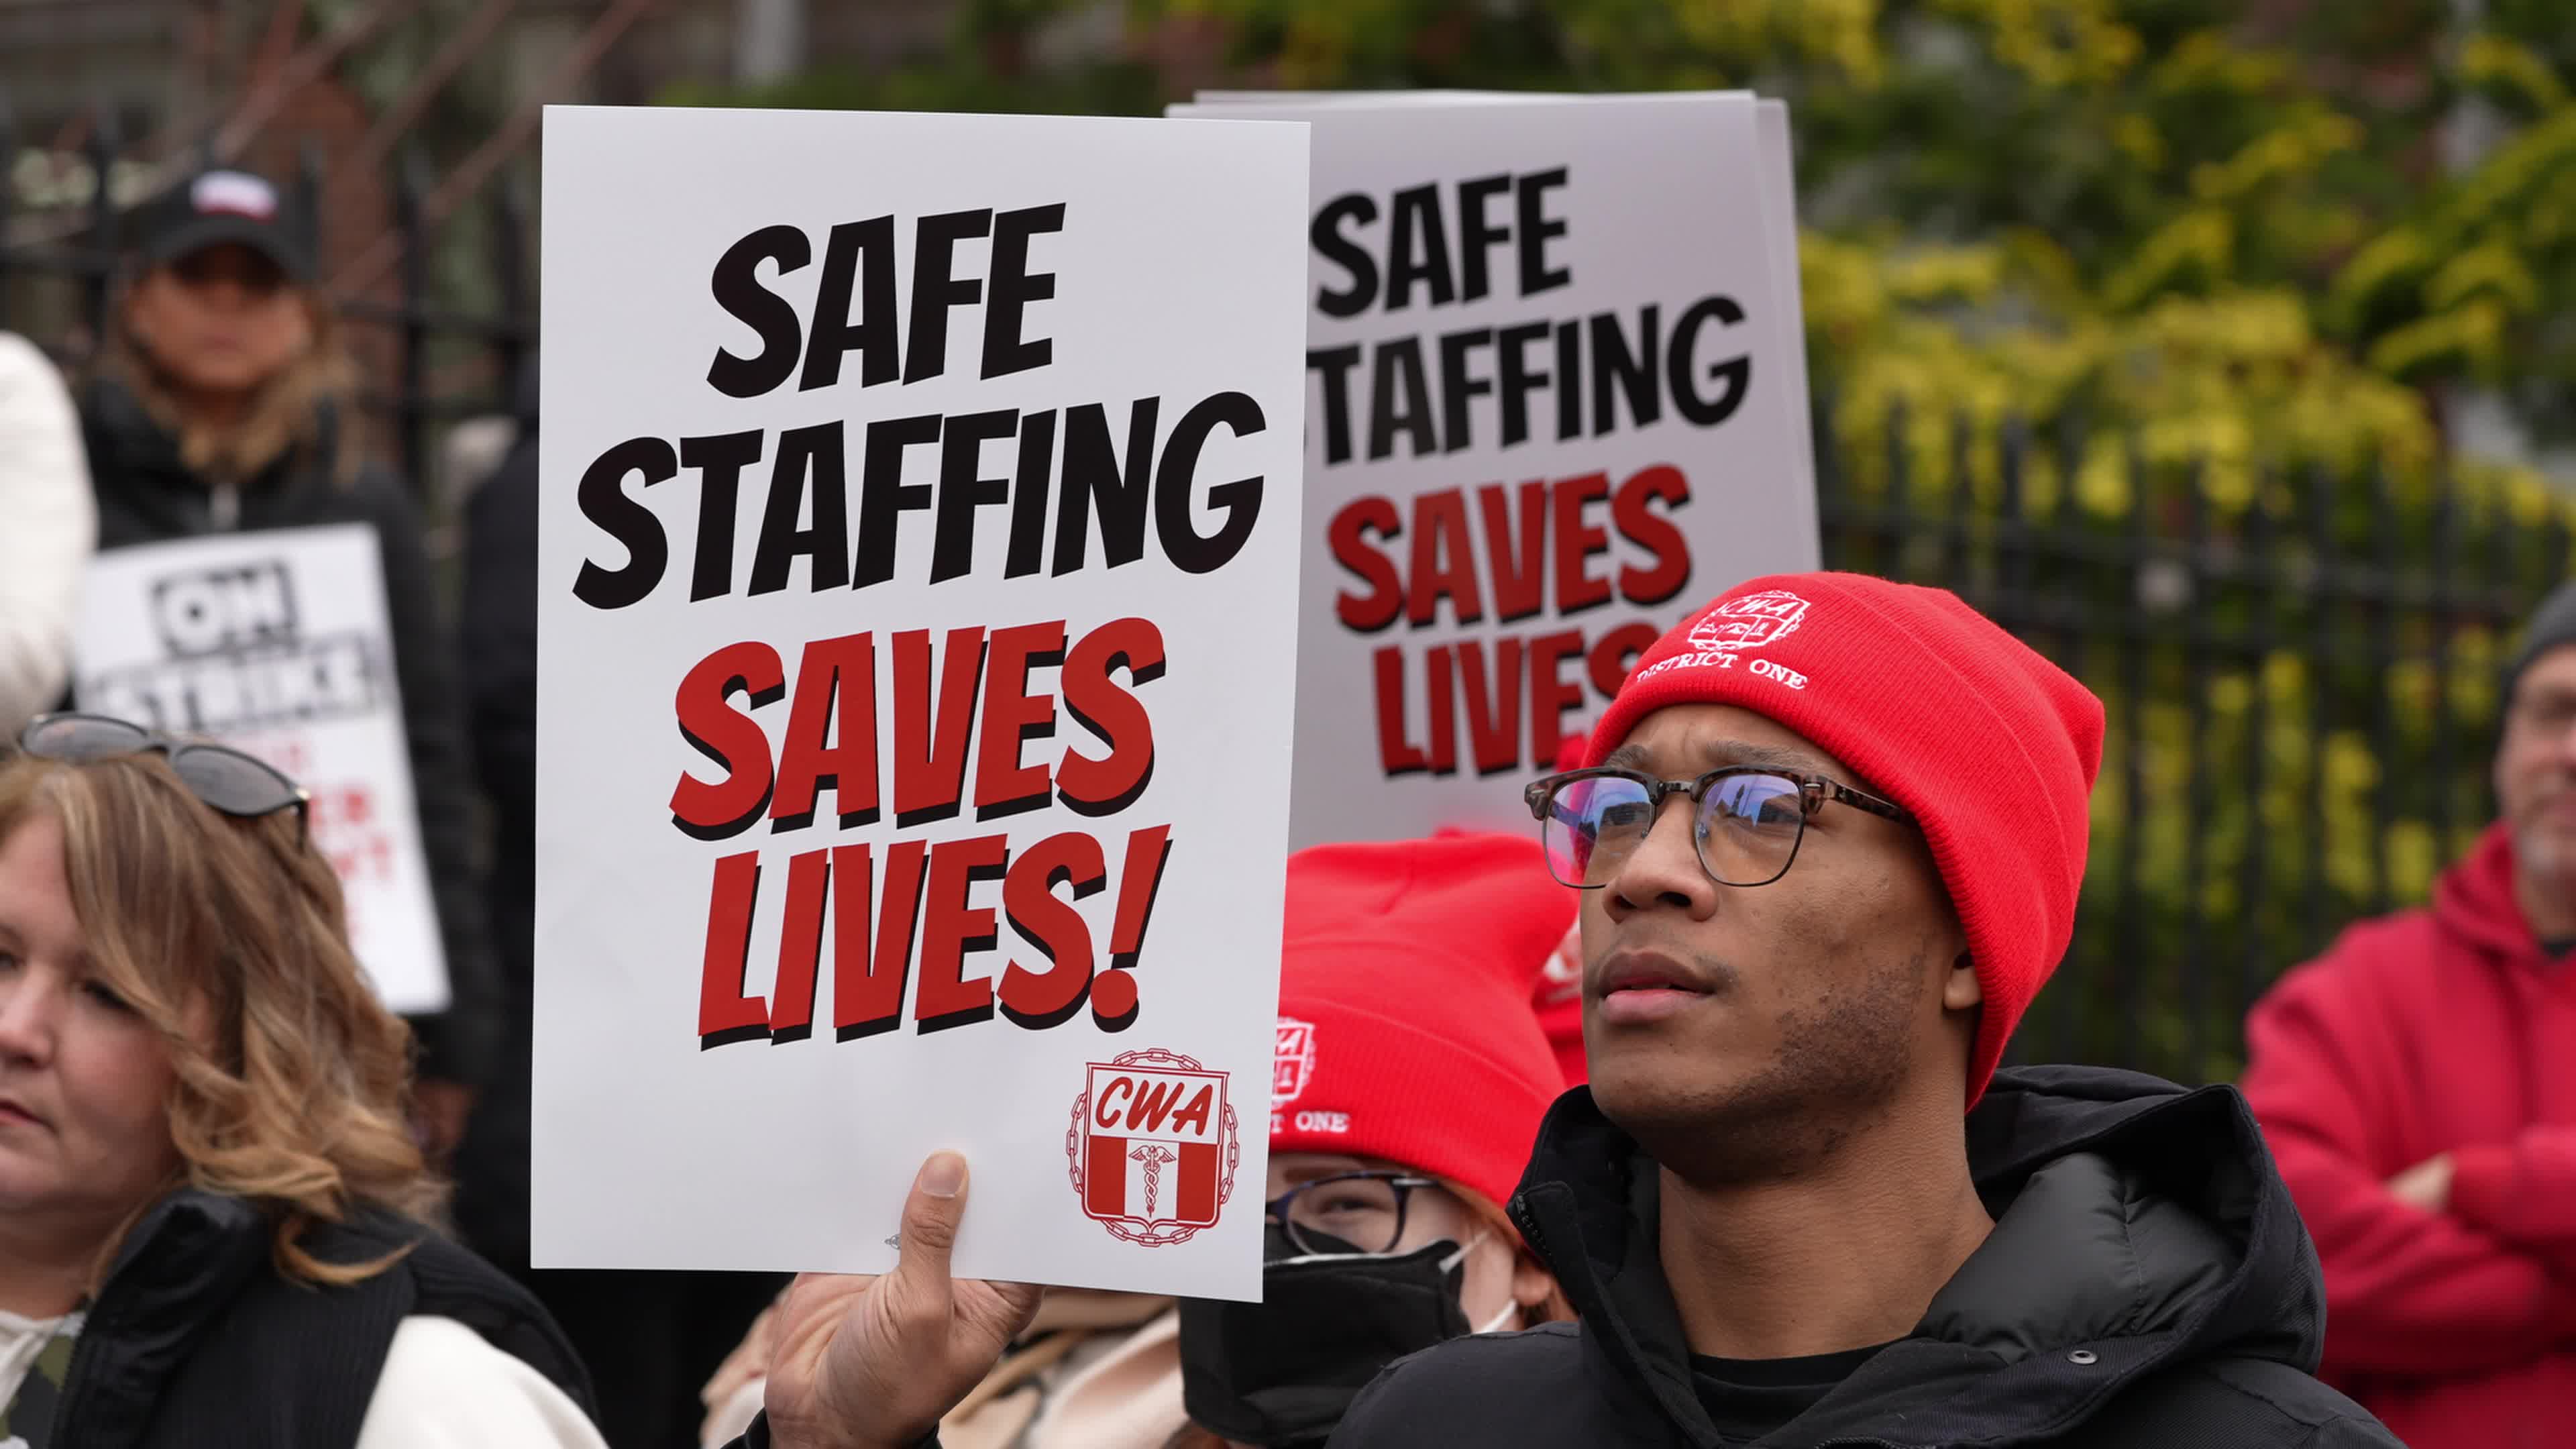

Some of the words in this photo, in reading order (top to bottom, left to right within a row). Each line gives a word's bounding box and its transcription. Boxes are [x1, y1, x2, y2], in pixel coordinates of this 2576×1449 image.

[706, 202, 1067, 399] SAFE
[1308, 166, 1572, 321] SAFE
[1304, 295, 1752, 468] TAFFING
[572, 391, 1267, 610] STAFFING
[1326, 464, 1693, 637] SAVES
[669, 617, 1167, 842] SAVES
[1372, 608, 1695, 777] LIVE
[1636, 651, 1739, 682] DISTRICT
[1749, 659, 1809, 690] ONE
[698, 823, 1173, 1053] LIVES!
[1095, 1076, 1214, 1136] CWA
[1295, 1110, 1350, 1133] ONE
